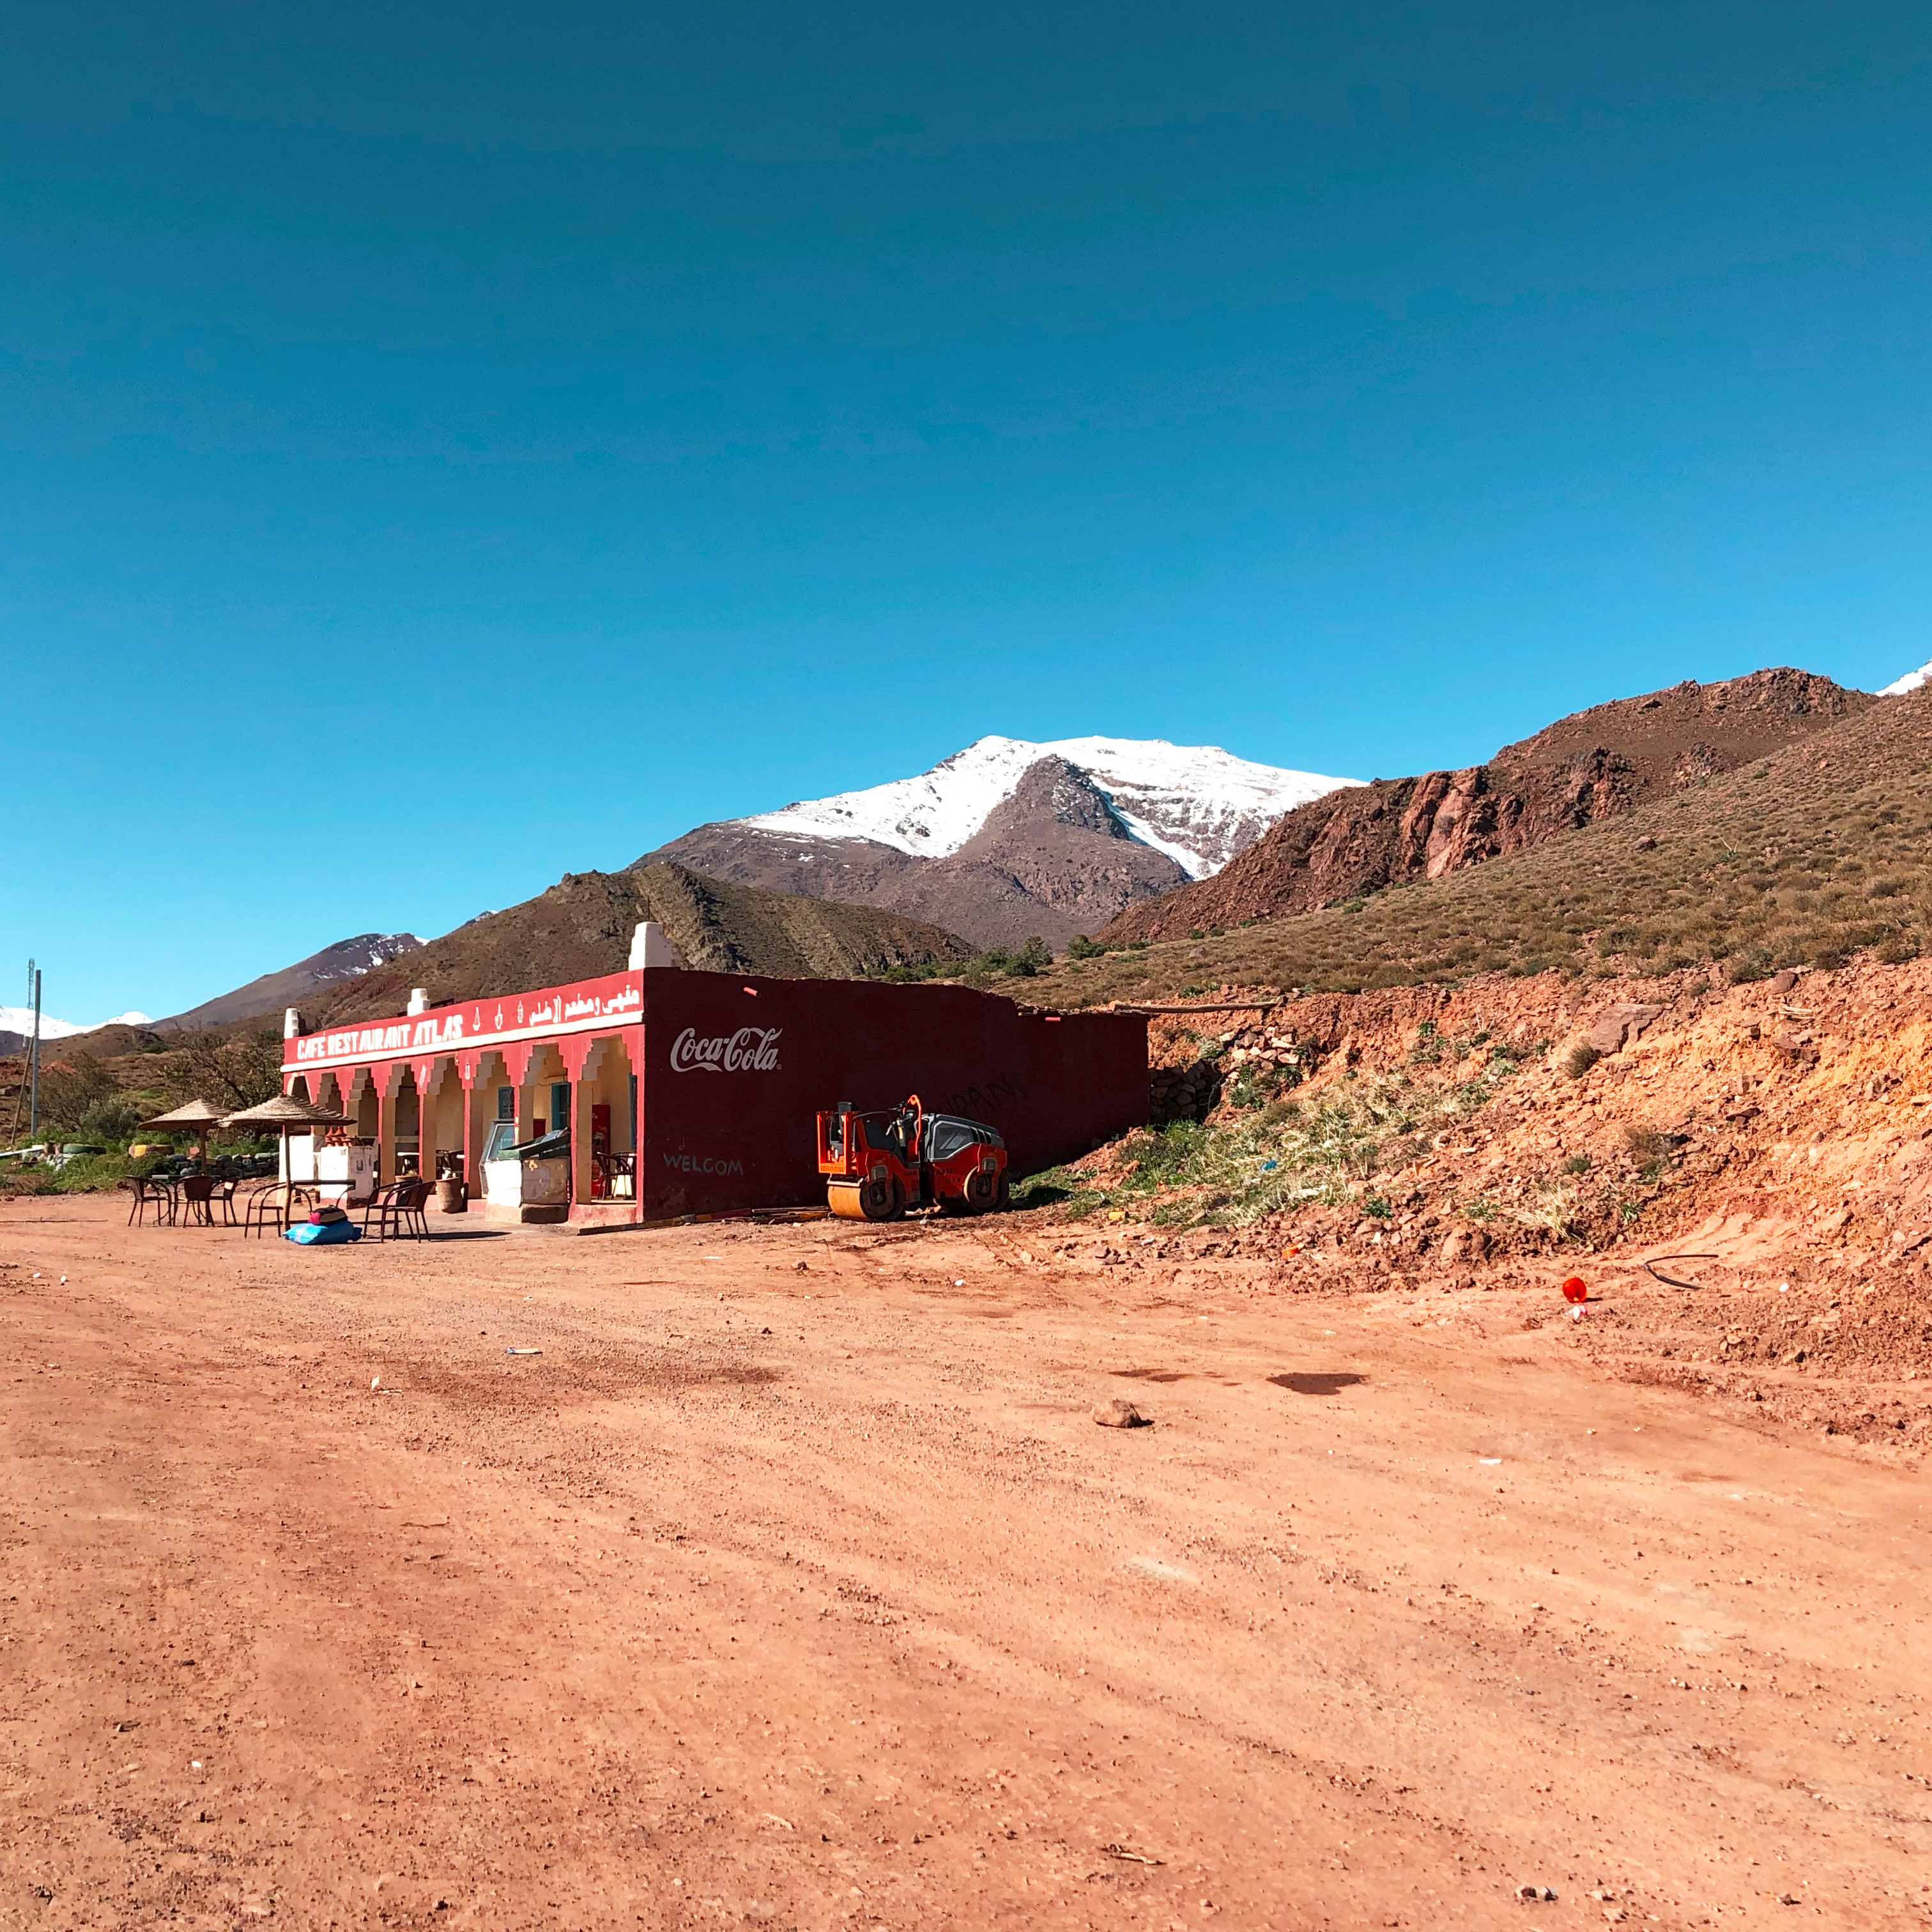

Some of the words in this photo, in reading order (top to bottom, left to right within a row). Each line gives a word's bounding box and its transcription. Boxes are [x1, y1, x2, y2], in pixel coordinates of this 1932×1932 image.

[327, 1024, 410, 1055] RESTAURANT
[413, 1015, 463, 1046] ATLAS
[670, 1027, 783, 1072] Coca-Cola
[663, 1152, 744, 1176] WELCOM
